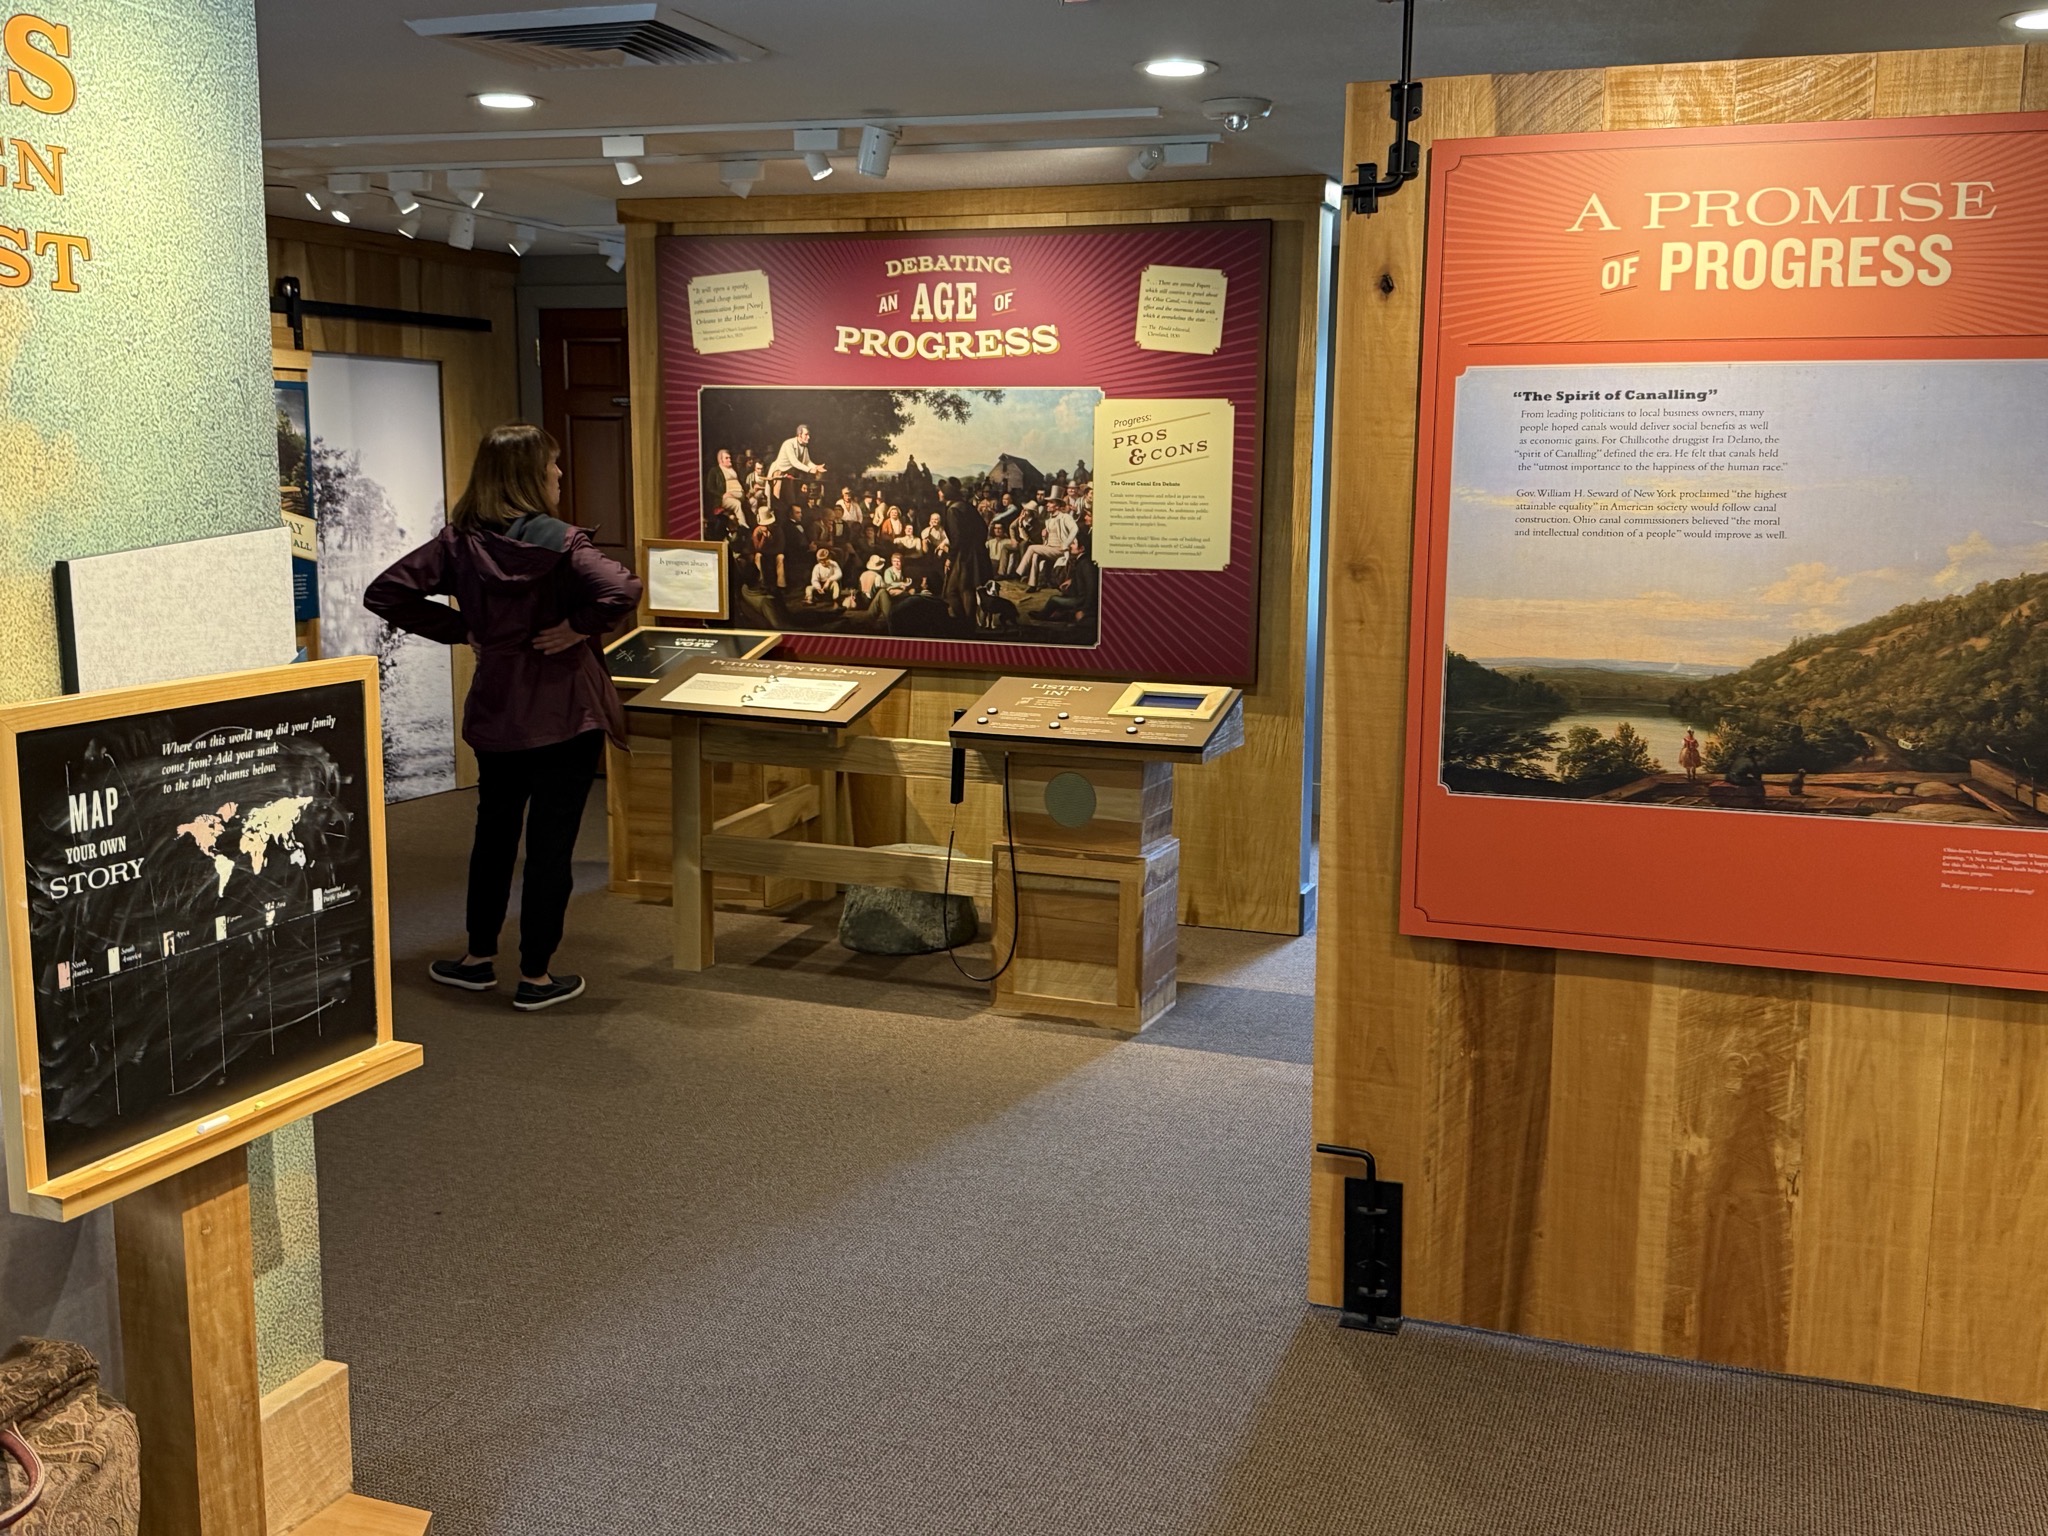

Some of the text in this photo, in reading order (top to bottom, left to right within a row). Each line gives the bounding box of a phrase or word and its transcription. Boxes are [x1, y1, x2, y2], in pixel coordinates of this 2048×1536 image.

[0, 137, 68, 196] N
[1564, 181, 1998, 232] A PROMISE
[885, 254, 1012, 277] DEBATING
[1601, 233, 1954, 292] OF PROGRESS
[878, 282, 1013, 322] AN AGE OF
[834, 324, 1060, 360] PROGRESS
[1556, 390, 1600, 403] Spirit
[1604, 390, 1622, 400] of
[1113, 414, 1152, 428] Progress:
[1521, 409, 1544, 418] From
[1547, 409, 1577, 420] leading
[1580, 409, 1625, 420] politicians
[1640, 408, 1660, 417] local
[1664, 408, 1699, 417] business
[1739, 410, 1764, 418] many
[1520, 423, 1548, 433] people
[1552, 423, 1578, 433] hoped
[1581, 422, 1607, 431] canals
[1610, 422, 1637, 431] would
[1640, 422, 1670, 430] deliver
[1673, 422, 1697, 430] social
[1700, 421, 1735, 430] benefits
[1750, 421, 1769, 430] well
[1112, 428, 1167, 449] PROS
[1575, 437, 1599, 446] gains.
[1601, 436, 1616, 444] For
[1619, 435, 1669, 444] Chillicothe
[1672, 435, 1709, 446] druggist
[1712, 435, 1724, 444] Ira
[1727, 435, 1763, 445] Delano,
[1765, 435, 1780, 444] the
[1150, 440, 1208, 461] CONS
[1543, 449, 1554, 457] of
[1604, 449, 1636, 457] defined
[1639, 449, 1653, 457] the
[1675, 449, 1689, 457] He
[1691, 449, 1706, 457] felt
[1709, 449, 1726, 457] that
[1729, 449, 1756, 457] canals
[1758, 449, 1779, 457] held
[1518, 463, 1531, 471] the
[1571, 463, 1621, 473] importance
[1635, 463, 1650, 471] the
[1653, 462, 1695, 473] happiness
[1698, 462, 1709, 471] of
[1710, 462, 1725, 471] the
[1727, 462, 1759, 471] human
[1516, 489, 1536, 498] Gov.
[1537, 489, 1571, 497] William
[1574, 489, 1585, 498] H.
[1587, 489, 1618, 498] Seward
[1621, 489, 1632, 498] of
[1633, 489, 1655, 498] New
[1656, 489, 1676, 498] York
[1680, 490, 1730, 500] proclaimed
[1754, 490, 1787, 501] highest
[1516, 502, 1556, 511] attainable
[1599, 503, 1609, 511] in
[1610, 503, 1654, 511] American
[1657, 503, 1688, 514] society
[1690, 503, 1719, 512] would
[1721, 503, 1751, 512] follow
[1753, 503, 1777, 512] canal
[1515, 516, 1571, 524] construction.
[1573, 516, 1597, 524] Ohio
[1599, 516, 1621, 524] canal
[1623, 516, 1689, 525] commissioners
[1692, 516, 1729, 525] believed
[1753, 517, 1781, 526] moral
[1514, 528, 1530, 536] and
[1532, 528, 1579, 537] intellectual
[1581, 528, 1624, 537] condition
[1627, 529, 1638, 538] of
[1683, 530, 1712, 539] would
[1714, 530, 1752, 541] improve
[1766, 531, 1788, 539] well.
[775, 663, 802, 671] PEN
[831, 667, 877, 676] PAPER
[1031, 683, 1093, 692] LISTEN
[162, 714, 336, 756] Where on this world map did your family
[161, 743, 279, 776] come from? Add your mark
[163, 783, 172, 794] to
[175, 779, 189, 792] the
[192, 772, 212, 790] tally
[214, 769, 250, 784] columns
[68, 786, 119, 834] MAP
[65, 835, 127, 865] YOUR OWN
[49, 857, 145, 900] STORY
